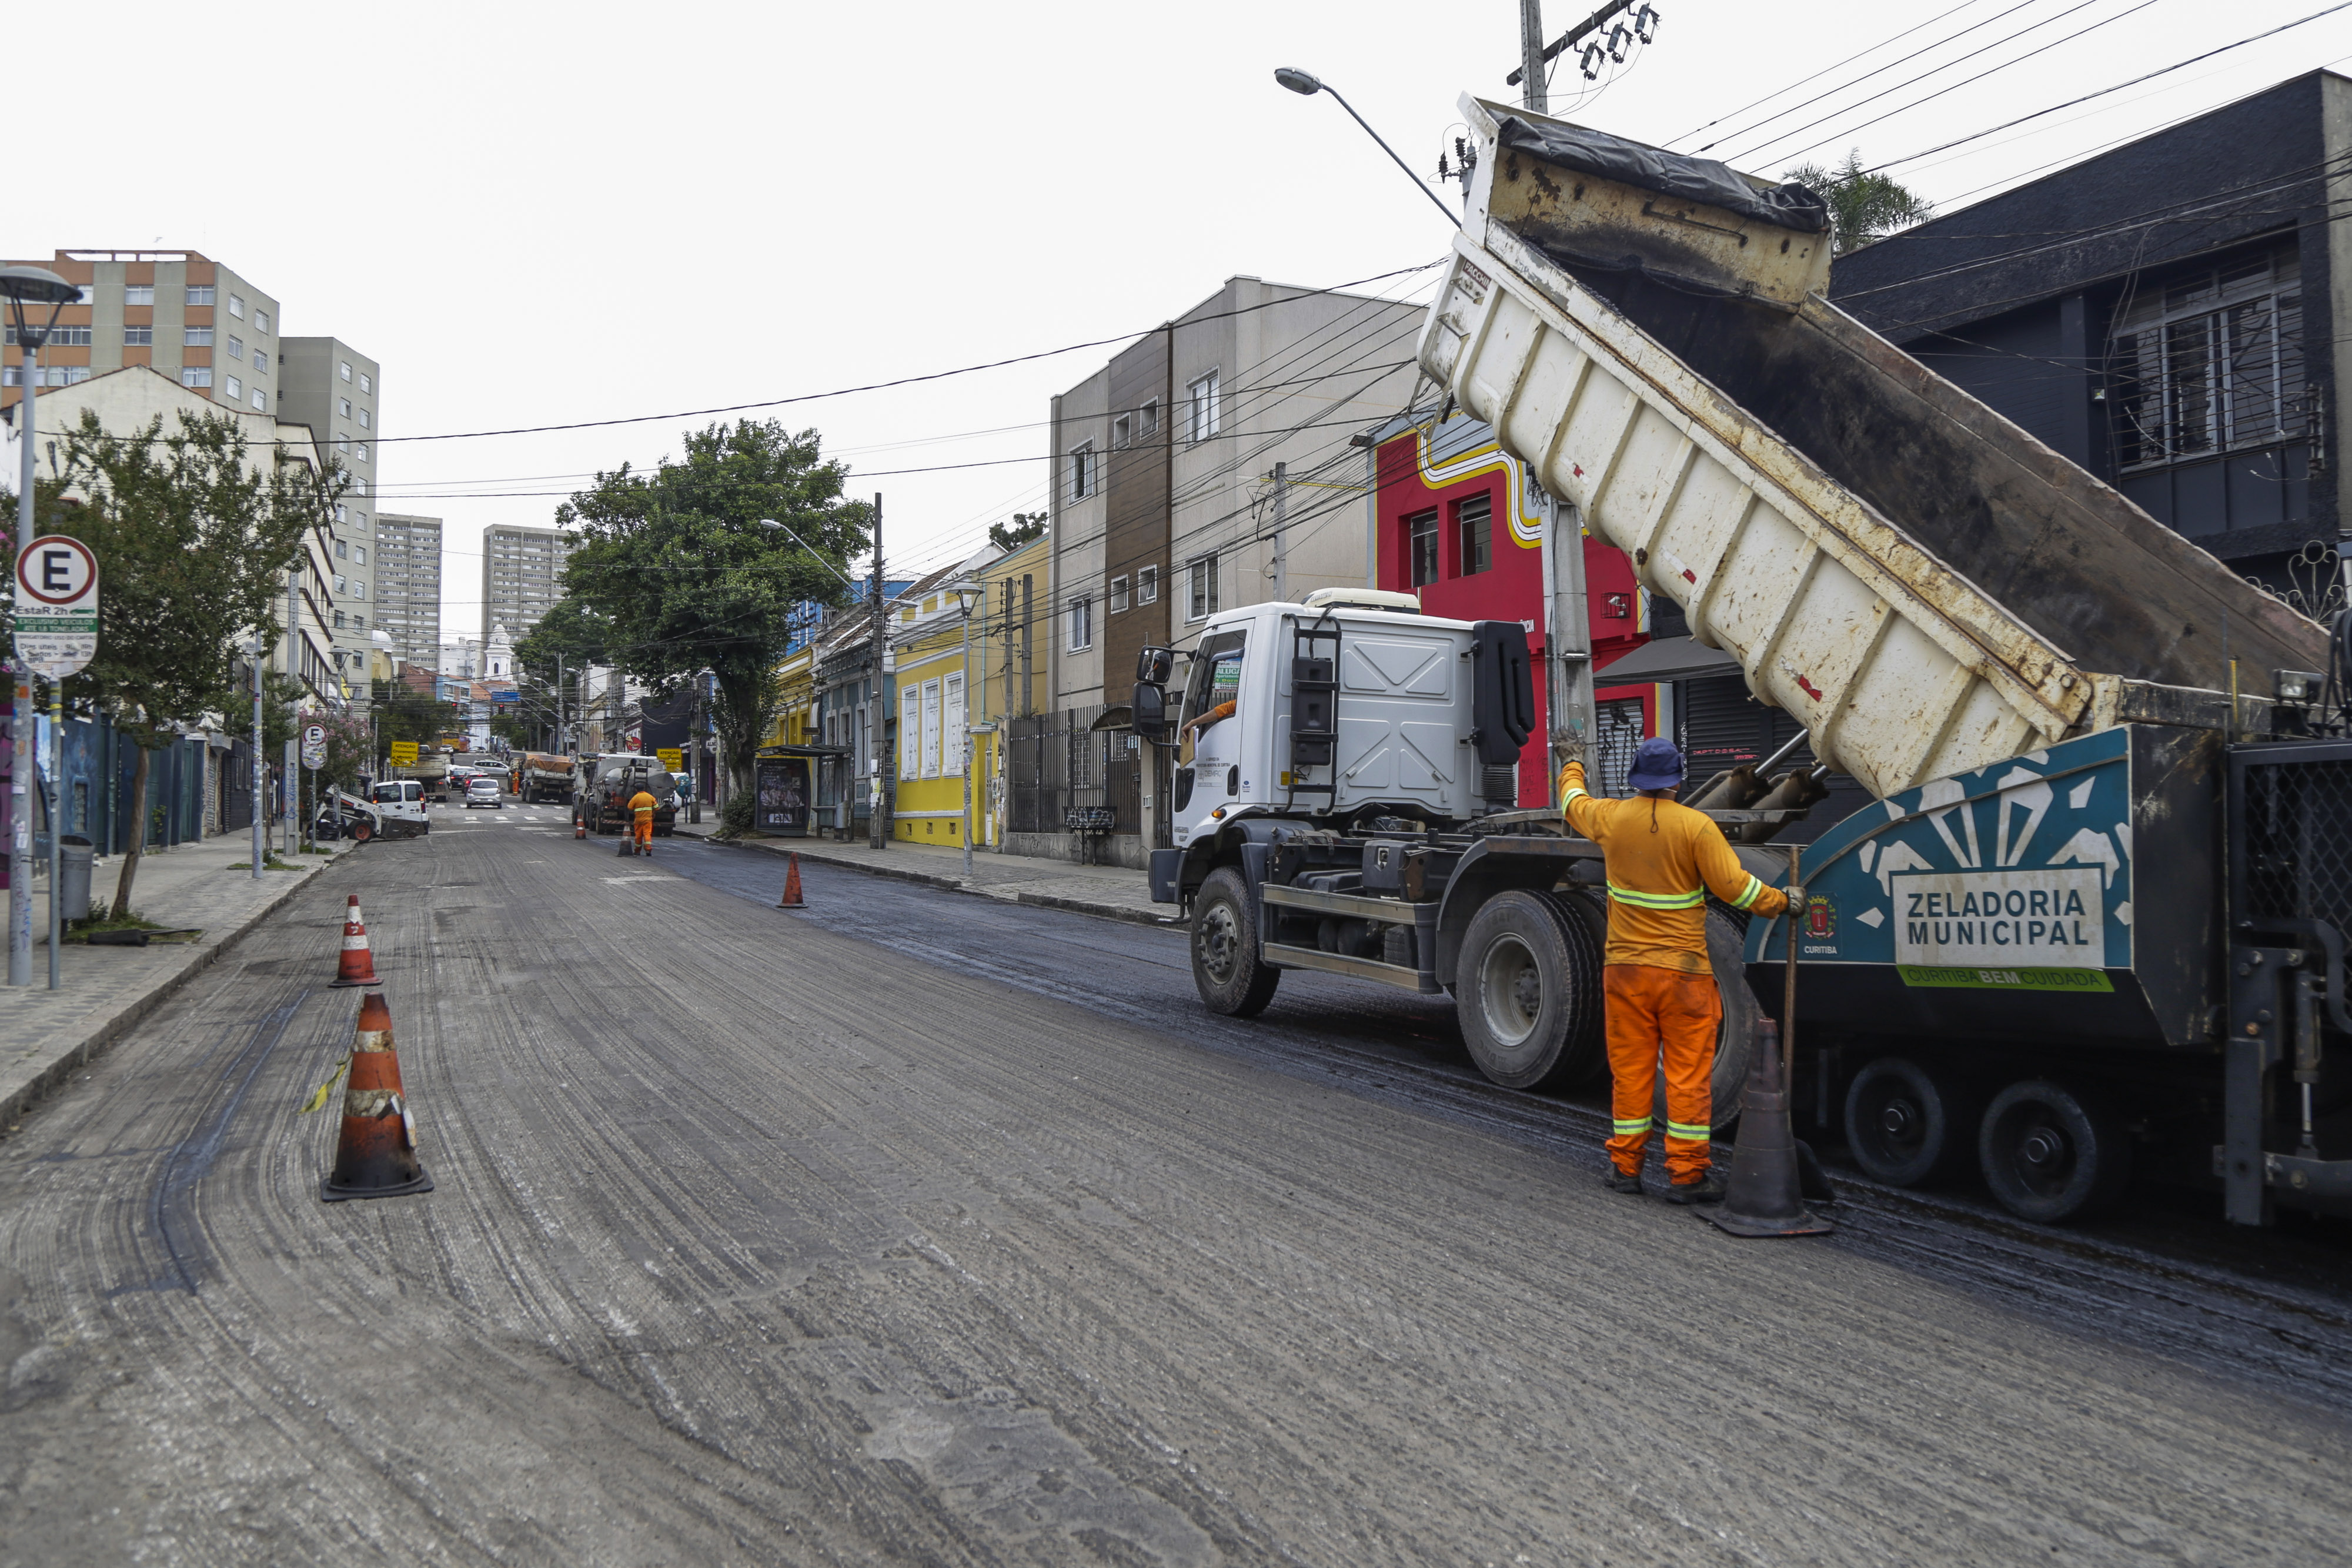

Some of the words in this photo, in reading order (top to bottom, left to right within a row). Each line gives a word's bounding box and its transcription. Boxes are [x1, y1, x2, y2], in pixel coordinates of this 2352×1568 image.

[43, 550, 71, 591] E
[16, 606, 51, 615] EstaR
[54, 606, 68, 616] 2h
[310, 728, 319, 741] E
[1907, 889, 2086, 917] ZELADORIA
[1907, 920, 2089, 945] MUNICIPAL
[1803, 945, 1838, 954] CURITIBA
